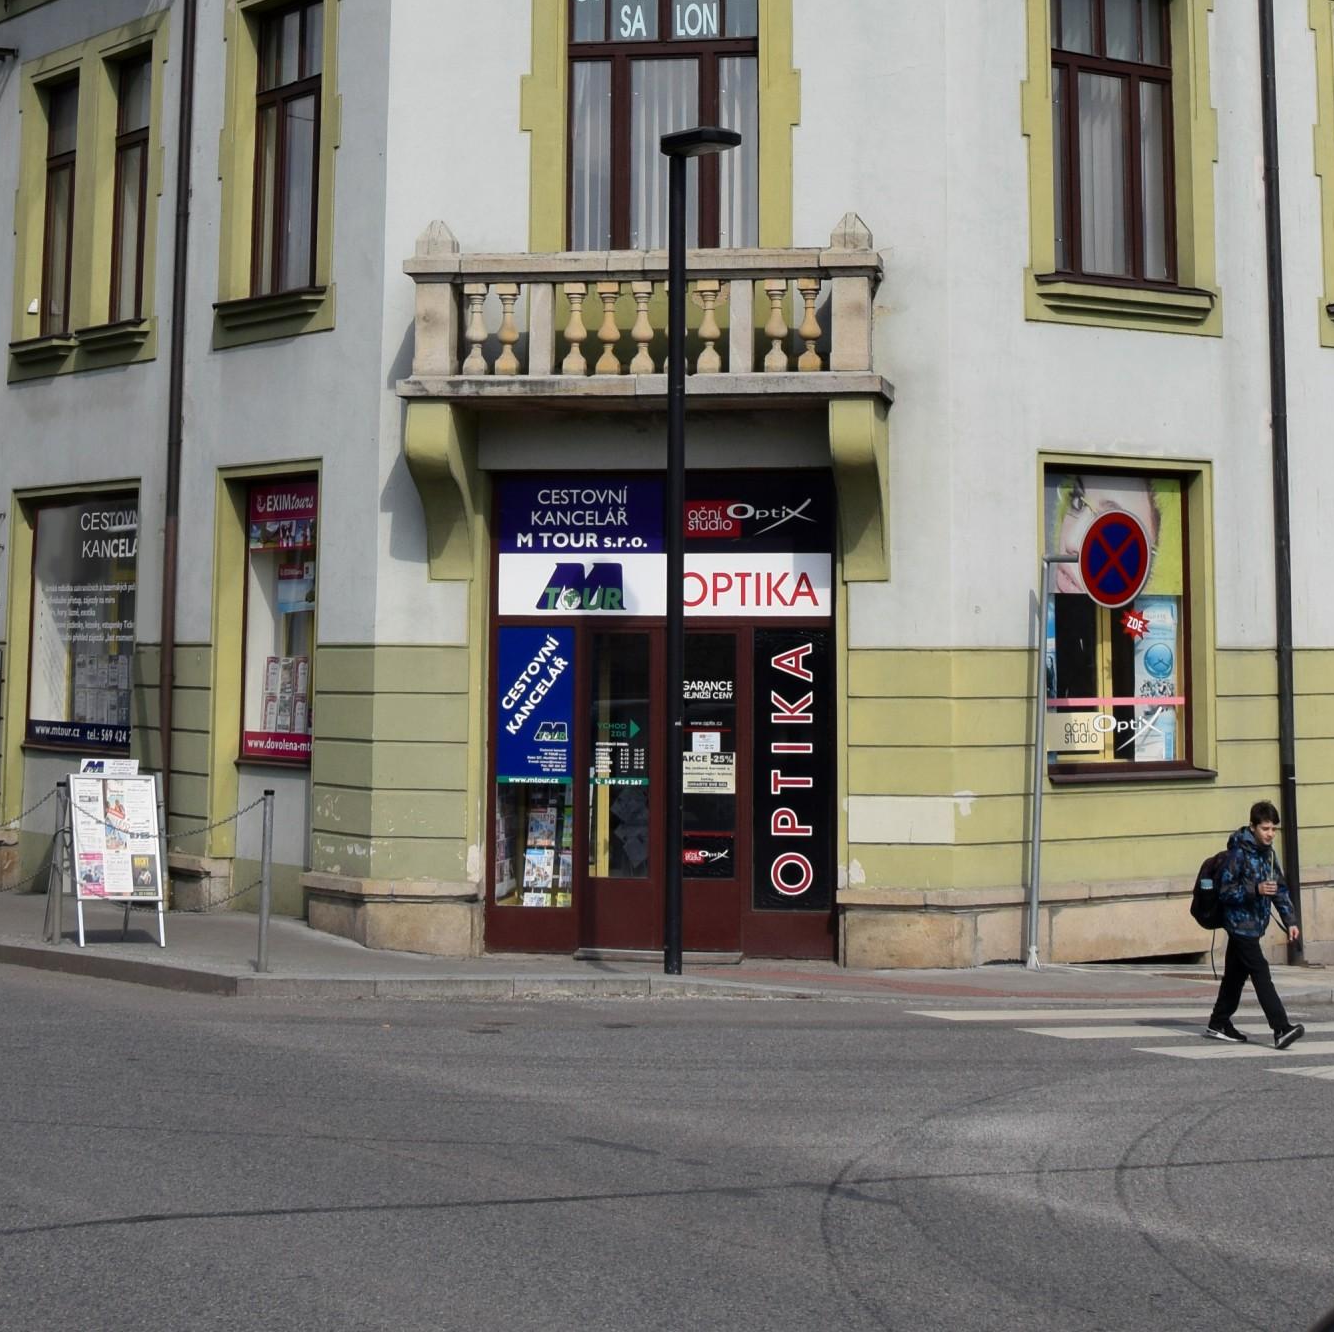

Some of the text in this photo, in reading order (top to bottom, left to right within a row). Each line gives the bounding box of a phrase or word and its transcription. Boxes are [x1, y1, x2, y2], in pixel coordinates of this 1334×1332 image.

[537, 486, 628, 504] CESTOVNÍ
[81, 510, 138, 530] CESTOVN
[531, 507, 629, 526] KANCELÁŘ
[688, 506, 722, 521] oční
[688, 518, 732, 531] studio
[517, 533, 648, 548] M TOUR s.r.o.
[683, 572, 819, 607] OPTIKA
[1126, 615, 1144, 632] ZDE
[502, 634, 560, 710] CESTOVNÍ
[505, 657, 569, 735] KANCELÁŘ
[35, 725, 80, 738] www.mtour.cz
[1064, 719, 1090, 734] oční
[1064, 730, 1098, 744] studio
[771, 643, 813, 896] OPTIKA
